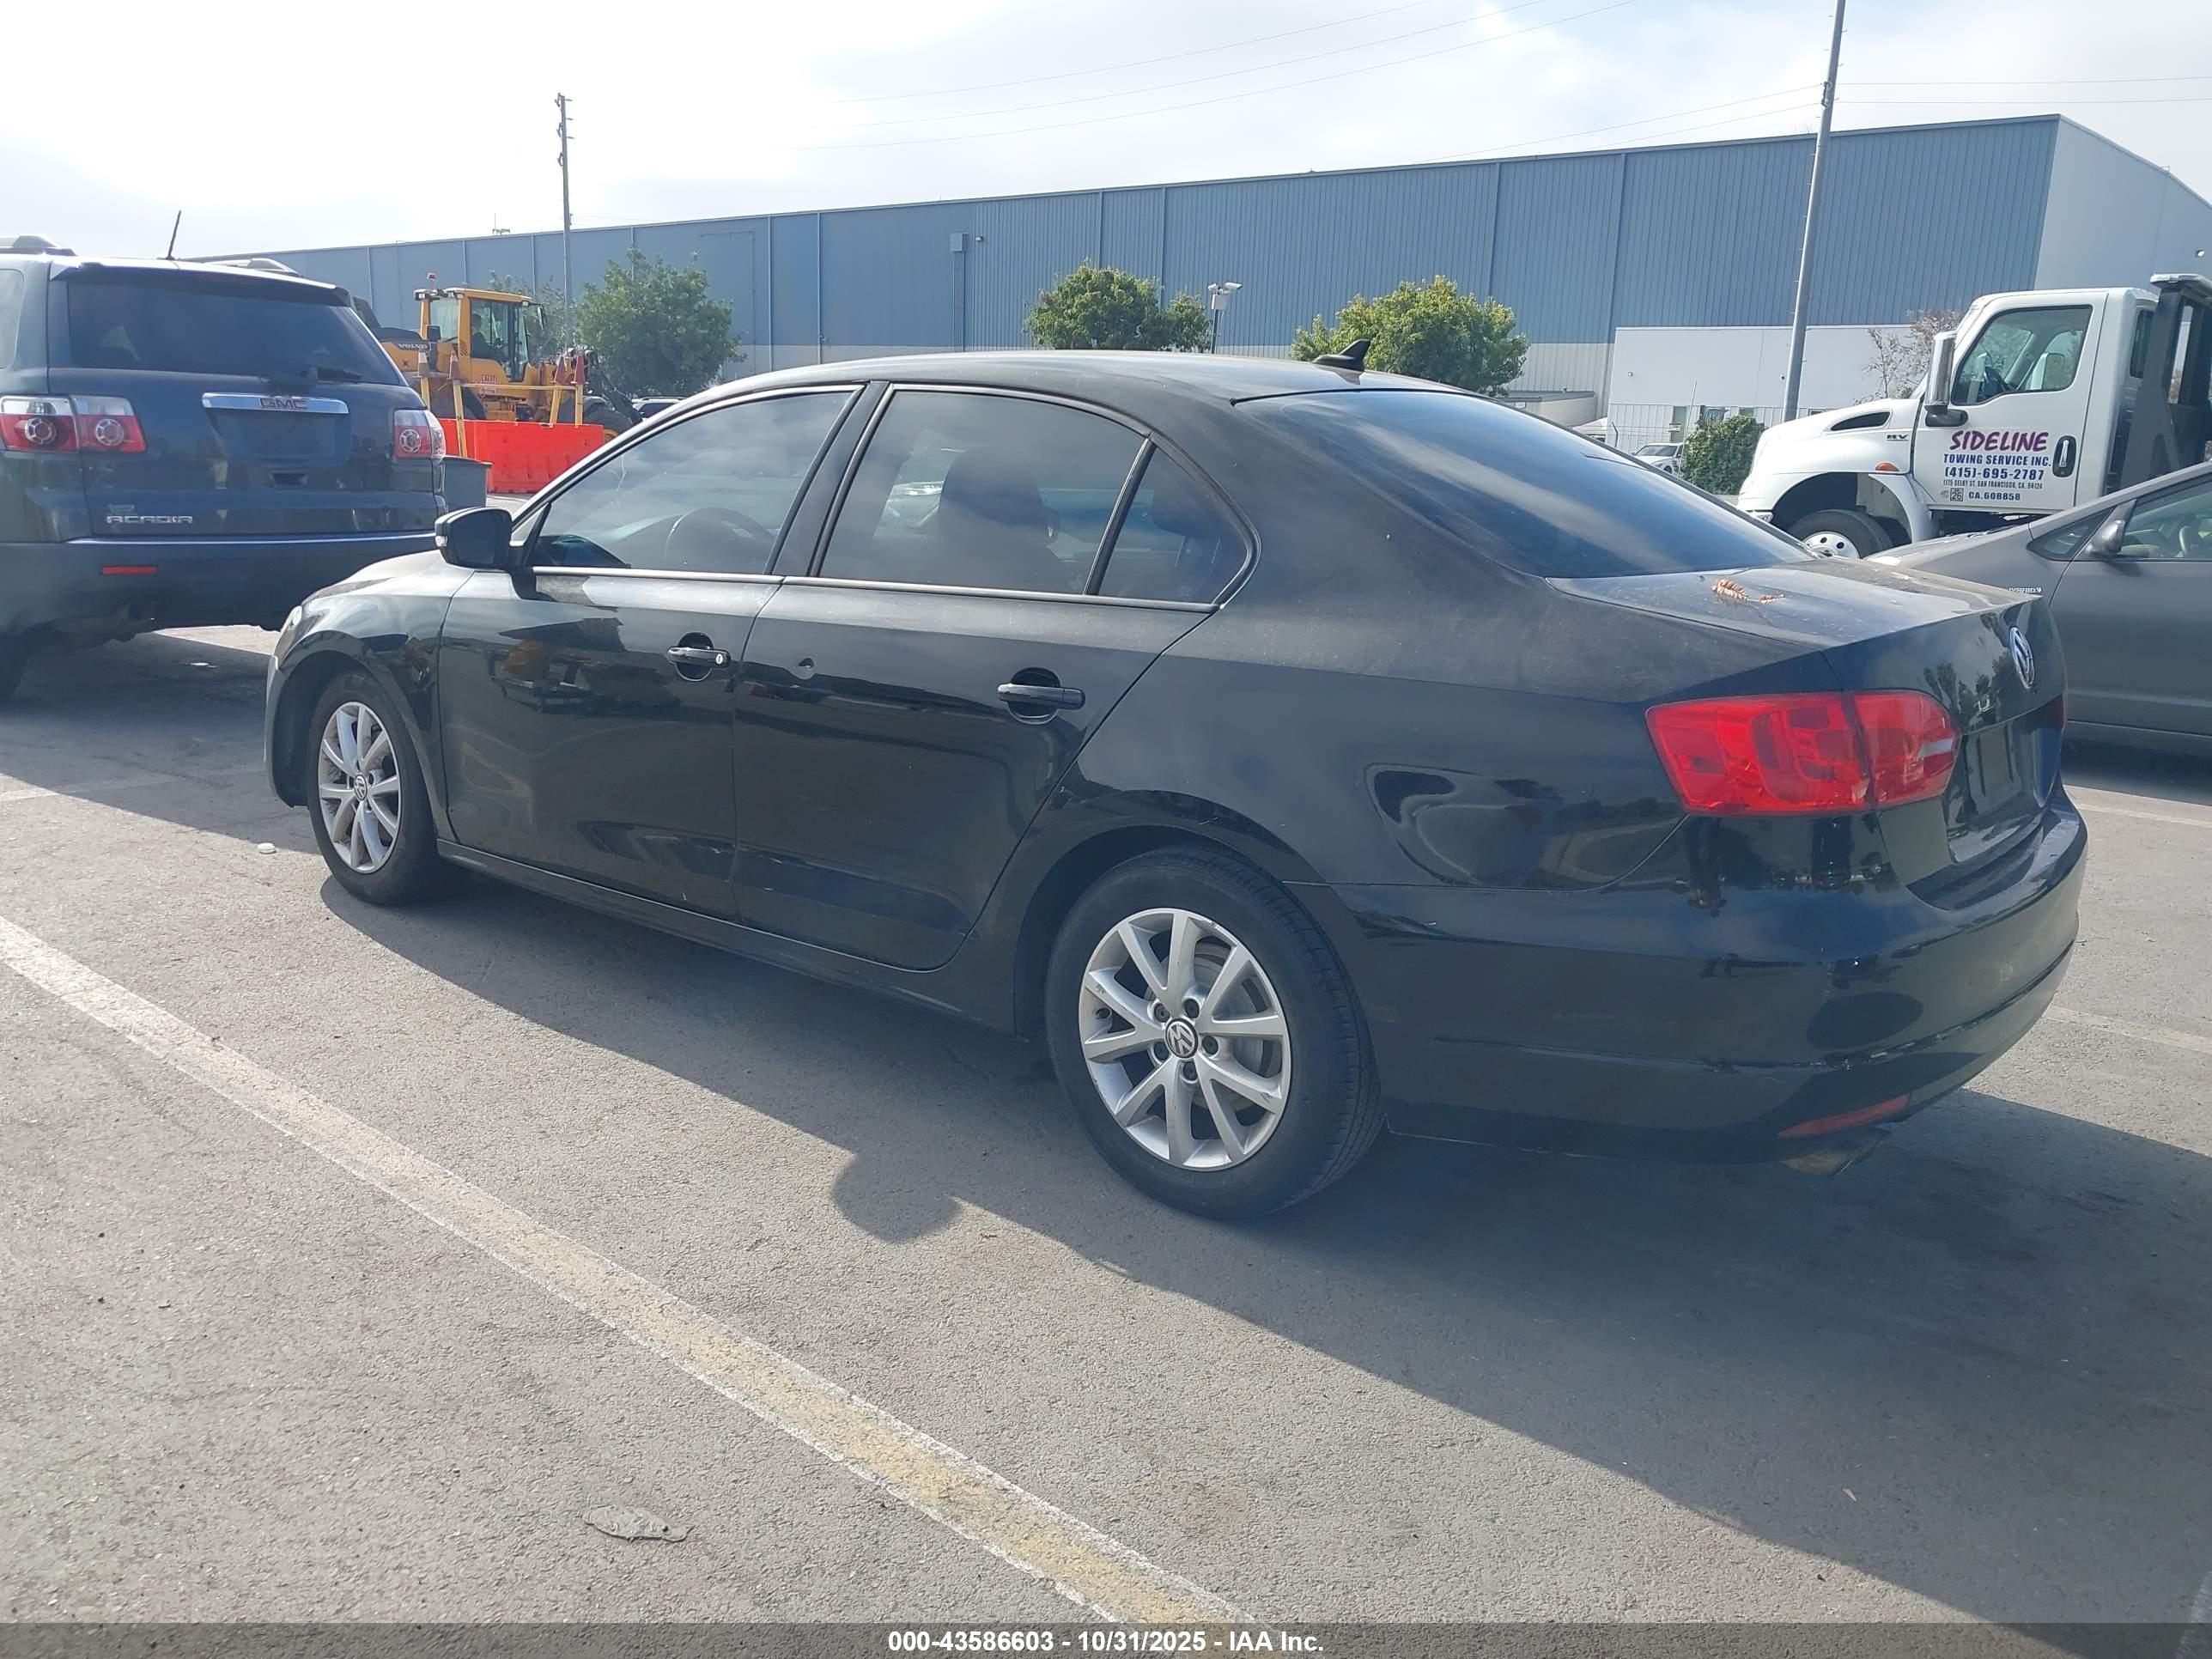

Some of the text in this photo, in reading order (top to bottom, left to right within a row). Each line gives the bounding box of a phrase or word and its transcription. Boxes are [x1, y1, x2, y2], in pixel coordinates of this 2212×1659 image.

[259, 398, 308, 410] GMC
[1949, 430, 2049, 453] SIDELINE
[1943, 453, 2051, 466] TOWING SERVICE INC.
[1945, 467, 2045, 480] (415)-695-2787
[106, 515, 193, 524] ACADIA
